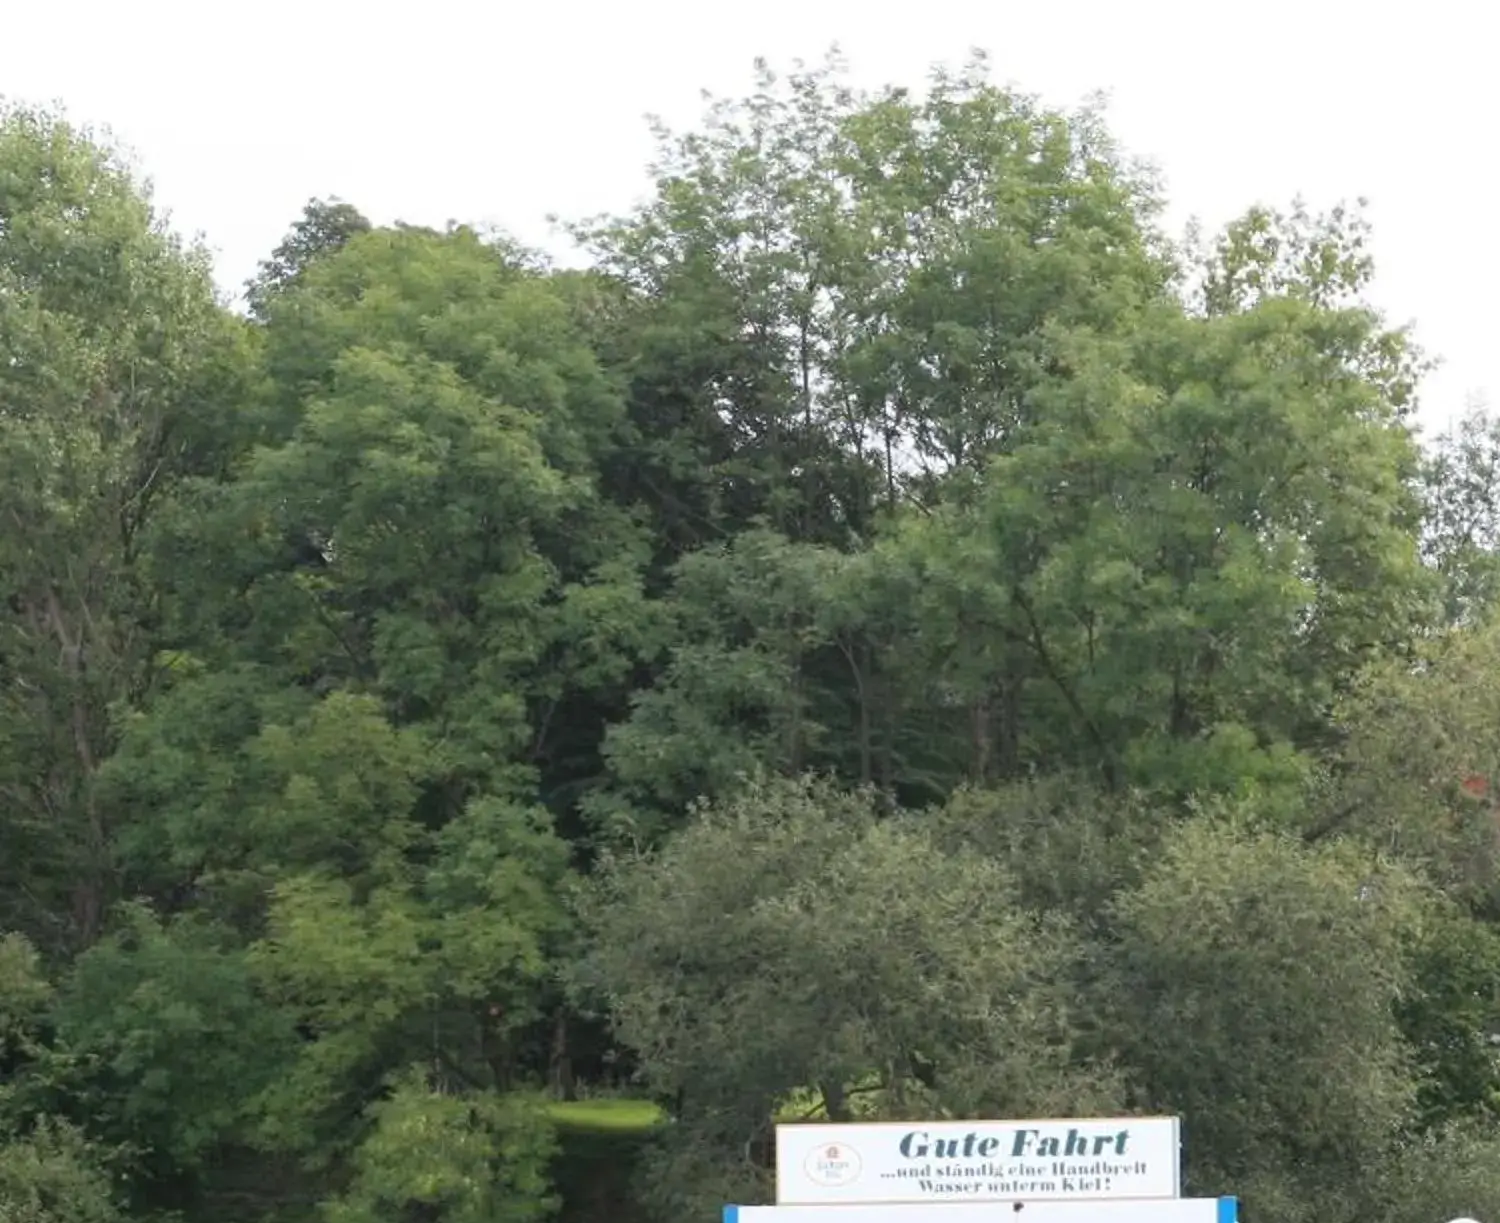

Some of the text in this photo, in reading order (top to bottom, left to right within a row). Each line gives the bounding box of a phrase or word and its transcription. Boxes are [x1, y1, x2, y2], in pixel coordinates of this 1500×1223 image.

[899, 1128, 1131, 1158] Gute Fahrt
[1007, 1162, 1047, 1176] eine
[1052, 1160, 1147, 1176] Handbreit
[919, 1177, 1111, 1193] Wasser unterm Kiel!
